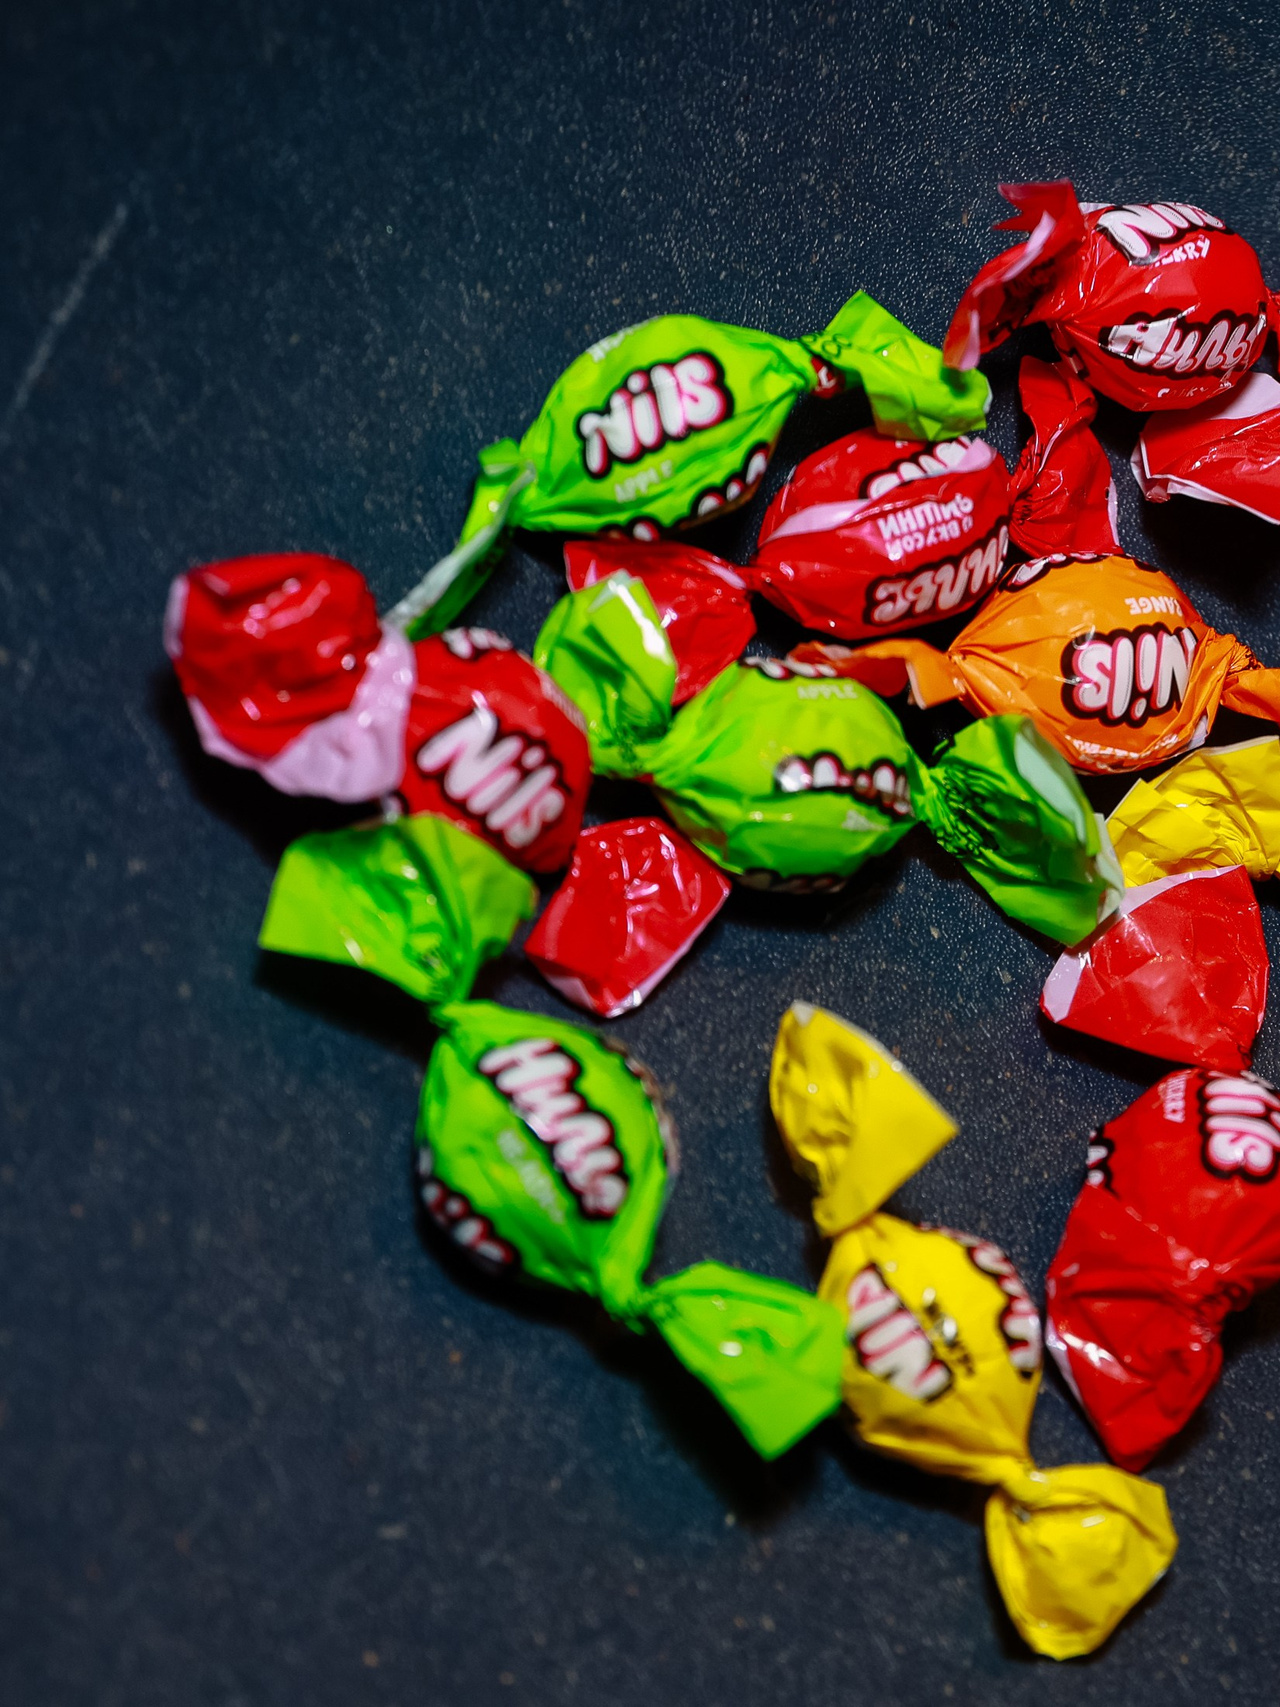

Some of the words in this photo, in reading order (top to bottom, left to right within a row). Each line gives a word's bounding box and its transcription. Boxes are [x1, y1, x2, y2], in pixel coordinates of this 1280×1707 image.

[579, 353, 730, 476] Nils
[1126, 597, 1182, 616] RANGE
[1073, 628, 1197, 718] Nils
[417, 708, 563, 848] Nils
[1163, 1076, 1186, 1124] HERRY
